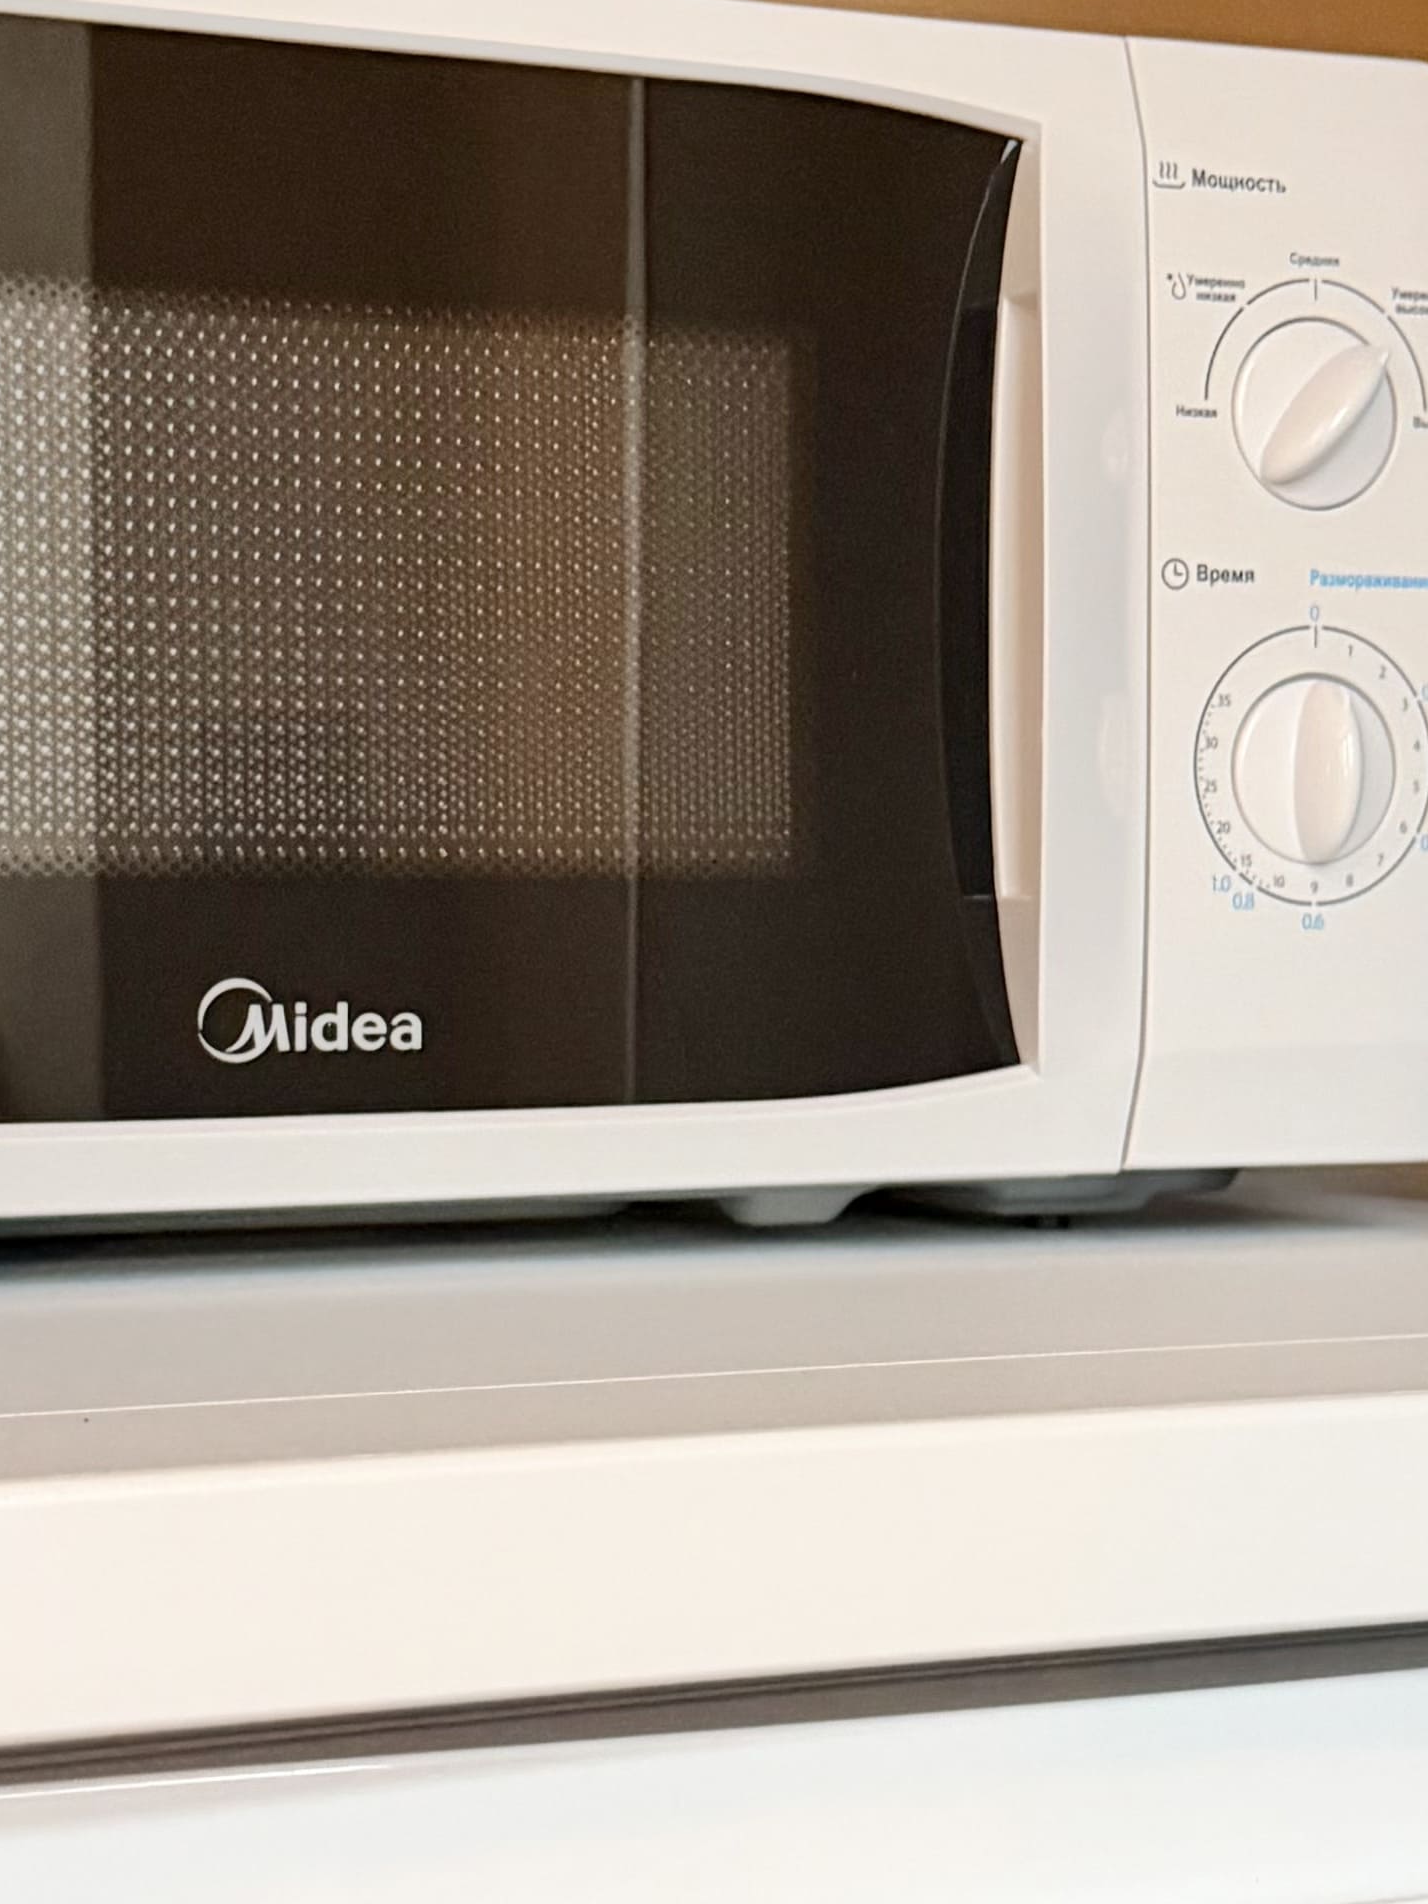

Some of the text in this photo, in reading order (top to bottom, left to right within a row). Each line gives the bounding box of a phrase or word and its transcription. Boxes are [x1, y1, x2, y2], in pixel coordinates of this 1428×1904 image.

[1191, 168, 1286, 194] Мощность
[1187, 273, 1246, 290] Умеренно
[1175, 404, 1218, 419] Низкая
[1196, 564, 1256, 587] Время
[1309, 605, 1320, 621] 0
[1347, 644, 1354, 657] 1
[1378, 664, 1387, 679] 2
[1413, 739, 1421, 752] 4
[1203, 779, 1218, 794] 25
[1216, 821, 1231, 835] 20
[1399, 820, 1408, 834] 6
[1240, 854, 1253, 868] 15
[1377, 853, 1385, 867] 7
[1212, 875, 1232, 893] 1.0
[1273, 874, 1286, 888] 10
[1310, 880, 1319, 894] 9
[1231, 893, 1256, 911] 0.8
[1301, 913, 1325, 931] 0.6
[197, 977, 422, 1064] Midea
